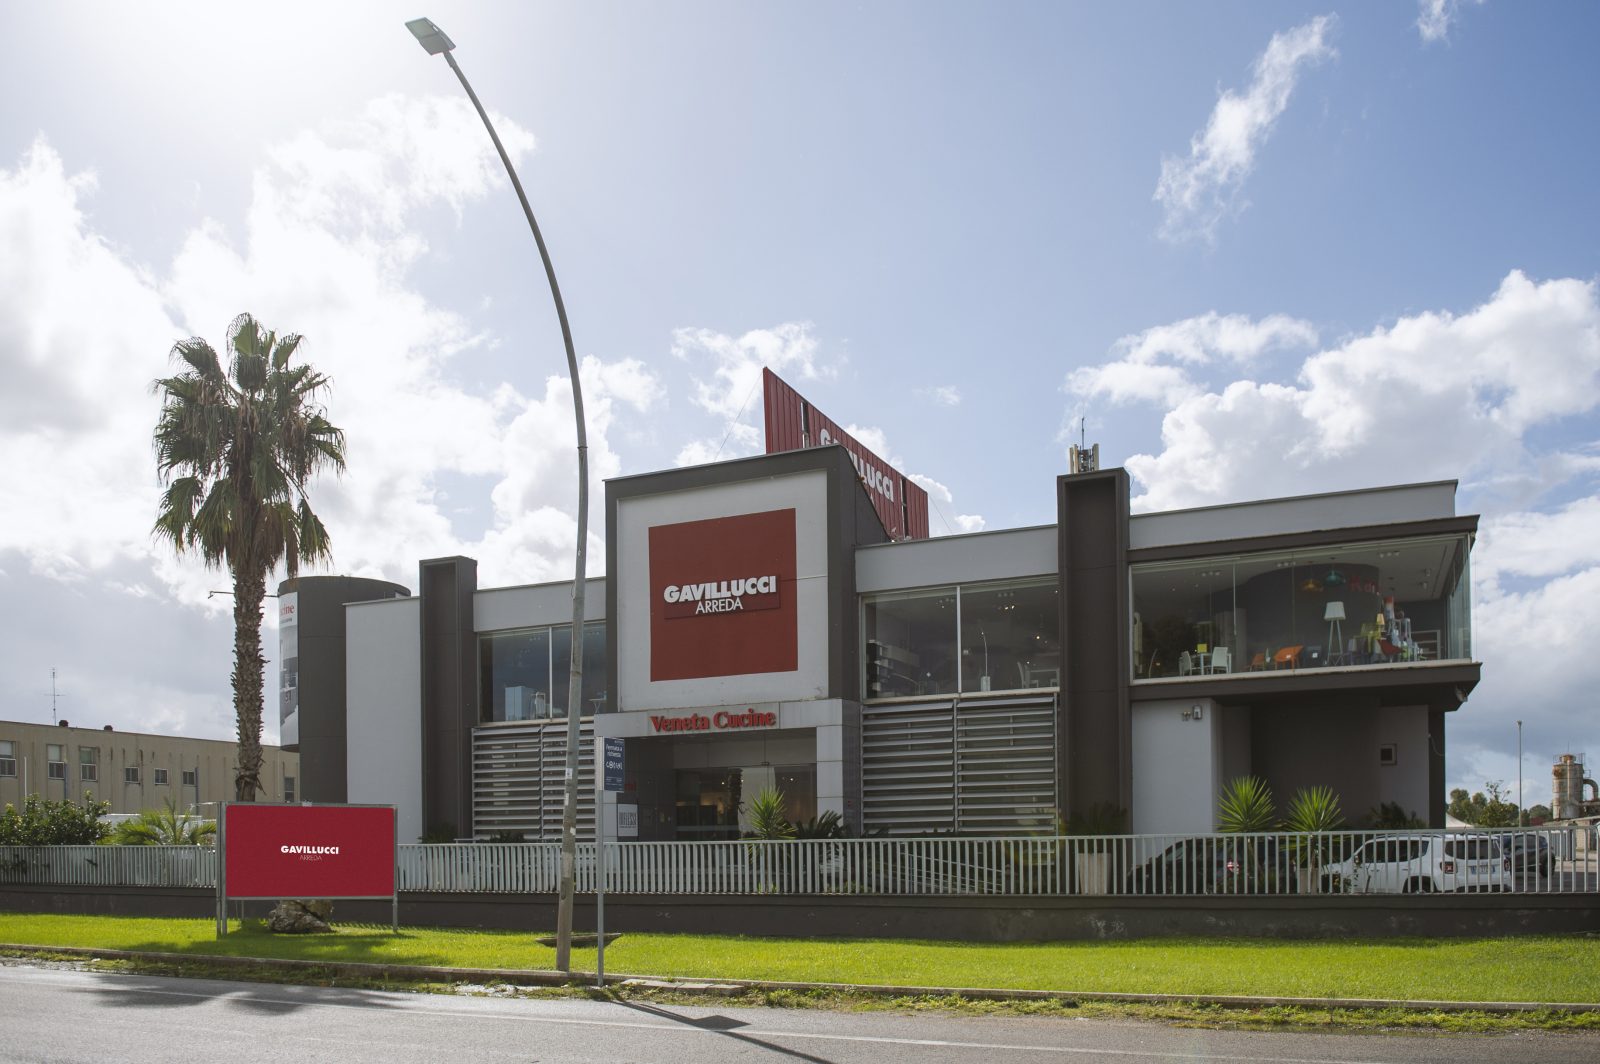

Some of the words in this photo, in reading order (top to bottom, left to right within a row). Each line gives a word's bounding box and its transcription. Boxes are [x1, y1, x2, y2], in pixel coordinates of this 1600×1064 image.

[820, 428, 894, 502] GLLUCCI
[664, 575, 777, 603] GAVILLUCCI
[695, 597, 744, 615] ARREDA
[650, 713, 710, 733] Veneta
[713, 708, 777, 729] Cucine
[280, 845, 340, 855] GAVILLUCCI
